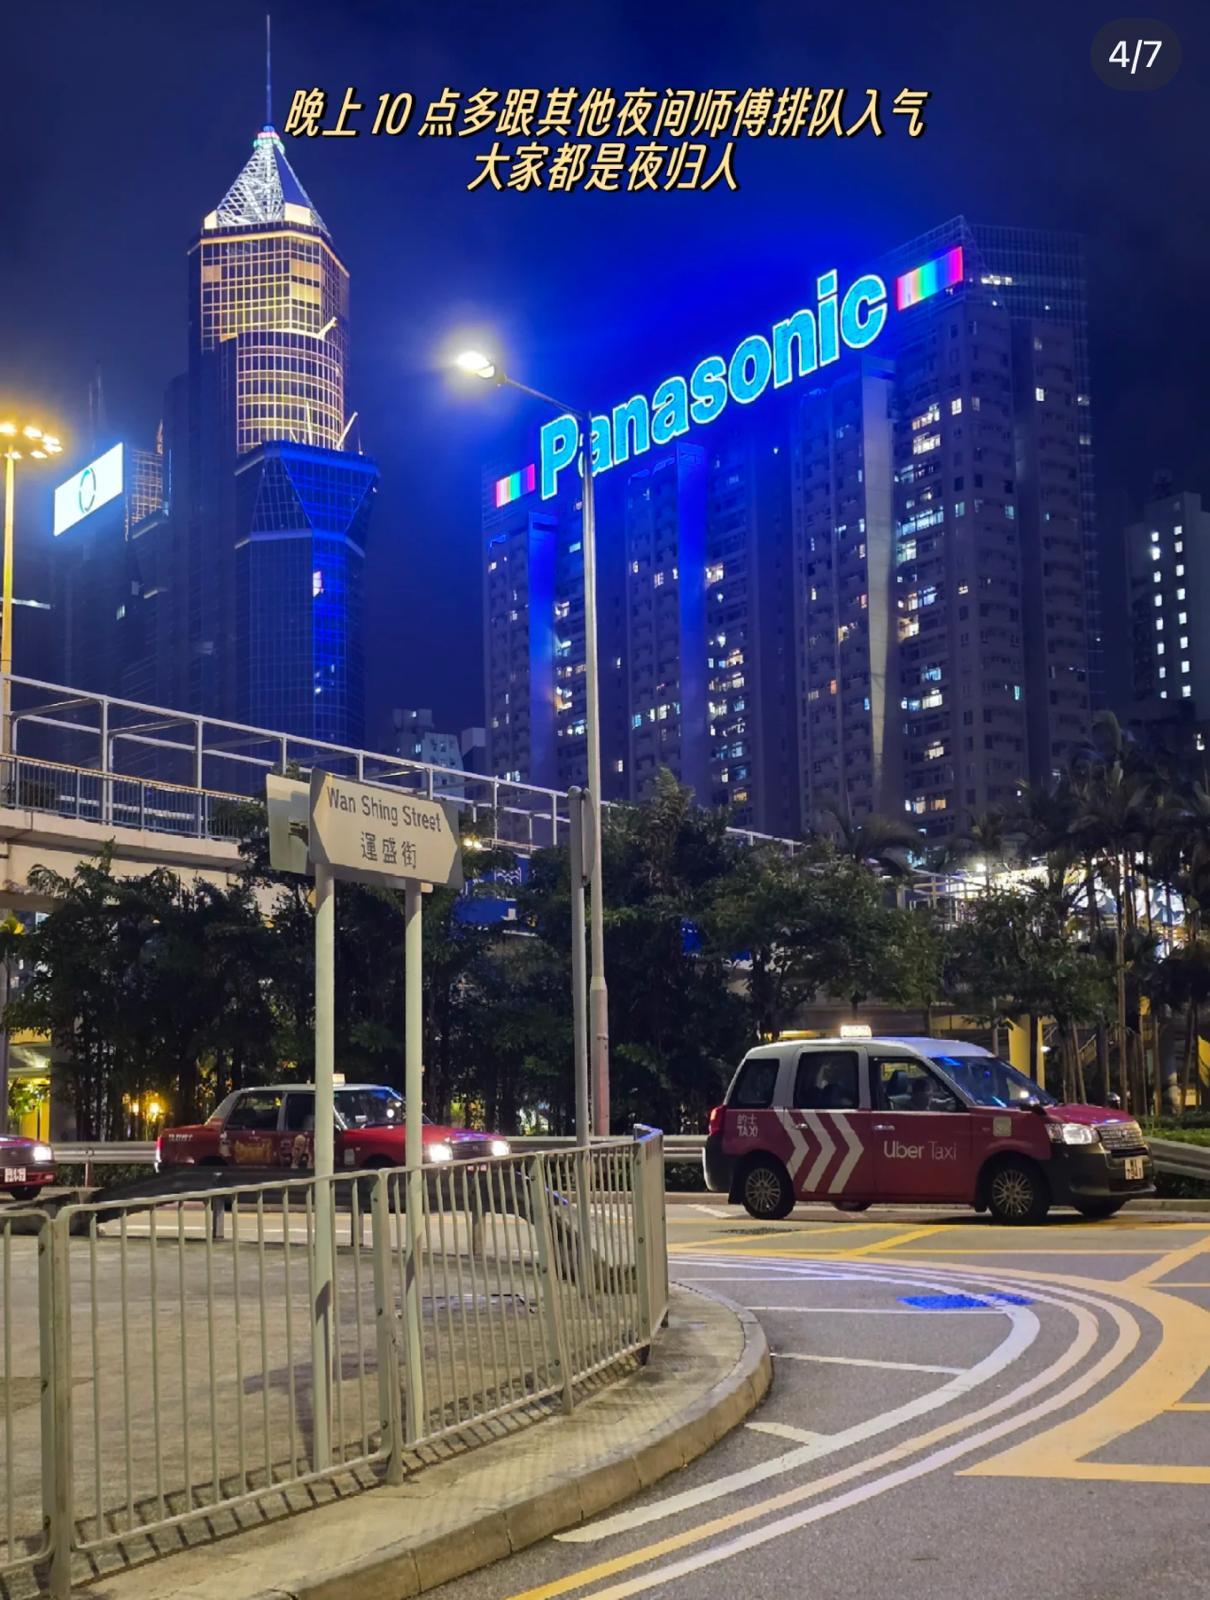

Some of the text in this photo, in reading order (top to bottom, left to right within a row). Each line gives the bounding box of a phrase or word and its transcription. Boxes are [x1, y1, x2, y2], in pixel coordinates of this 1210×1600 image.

[540, 269, 888, 500] Panasonic
[327, 786, 442, 832] Wan Shing Street
[360, 831, 416, 869] 運盛街
[736, 1125, 758, 1137] TAXI
[883, 1140, 957, 1160] Uber Taxi
